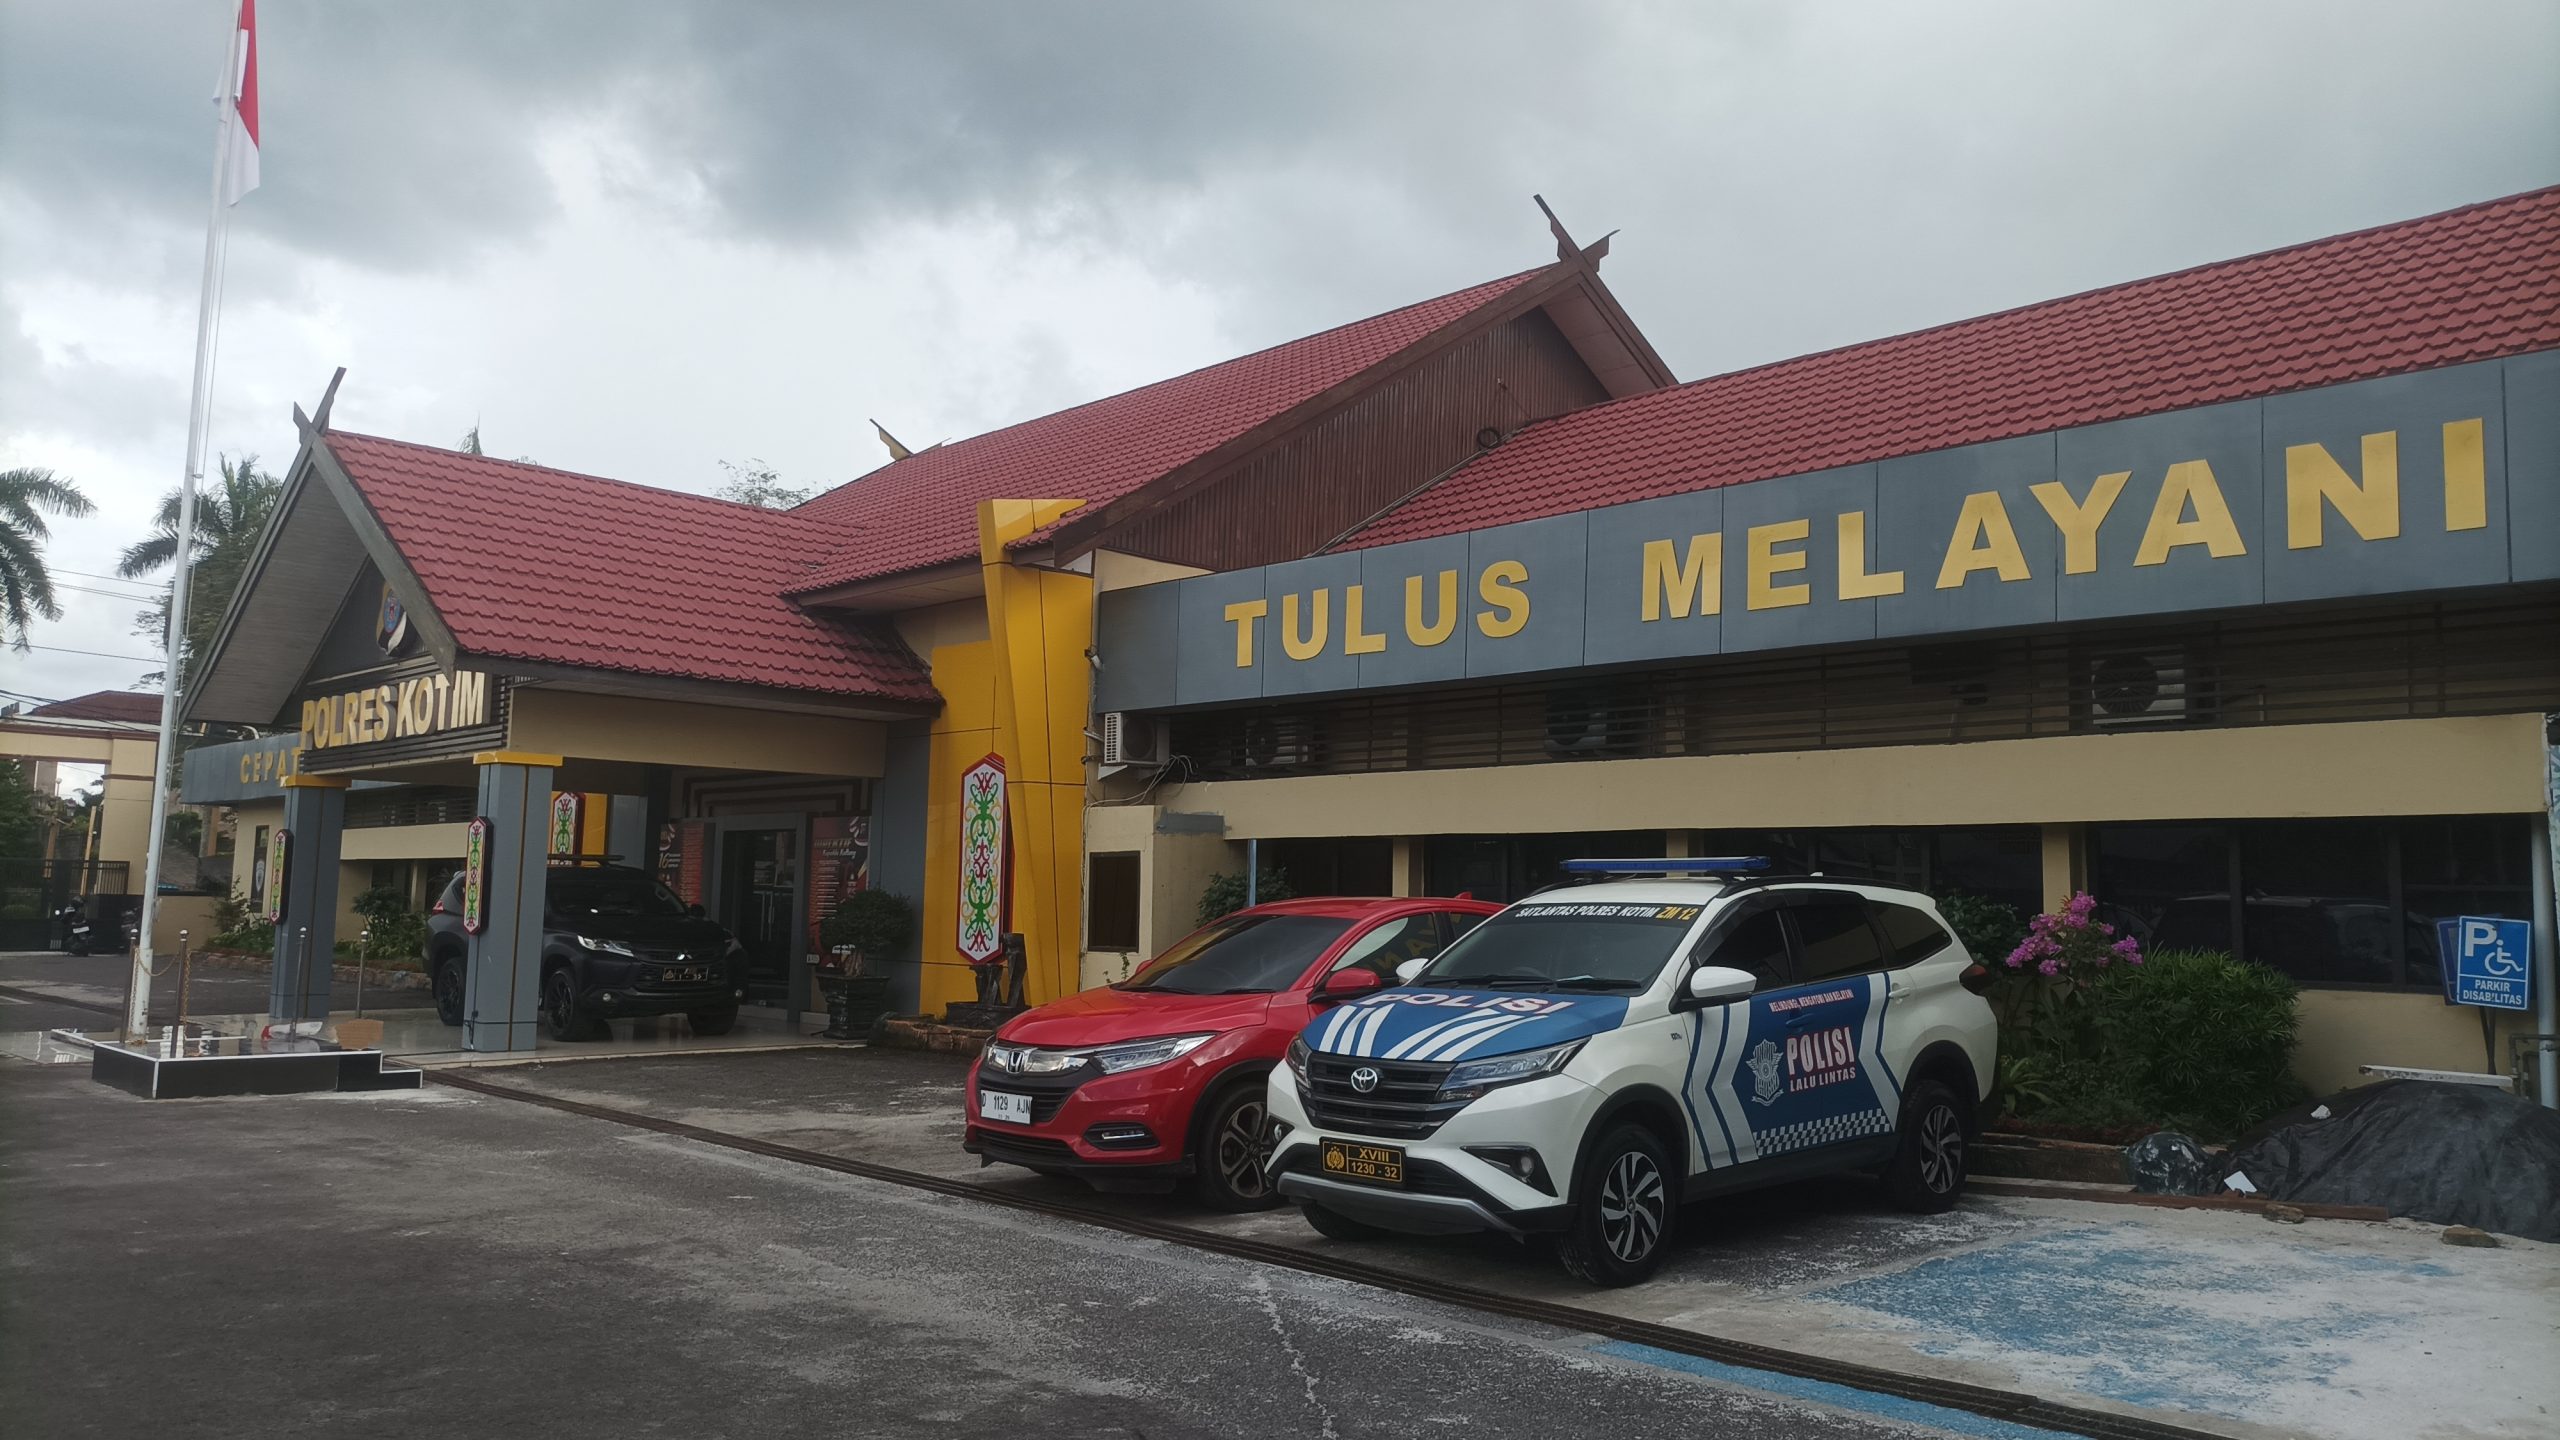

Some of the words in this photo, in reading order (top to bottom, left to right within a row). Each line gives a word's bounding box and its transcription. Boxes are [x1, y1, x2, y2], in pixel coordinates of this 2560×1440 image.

[1224, 560, 1531, 668] TULUS
[1641, 417, 2487, 623] MELAYANI
[301, 686, 390, 749] POLRES
[395, 669, 485, 738] KOTIM
[240, 746, 301, 784] CEPAT
[1515, 906, 1575, 918] SATLANTAS
[1575, 905, 1622, 917] POLRES
[1618, 906, 1661, 918] KOTIM
[1655, 906, 1684, 919] ZM
[1678, 907, 1699, 920] 12
[2464, 921, 2497, 957] P
[2474, 979, 2511, 992] PARKIR
[1359, 993, 1575, 1015] POLISI
[2462, 989, 2522, 1005] DISABILITAS
[1786, 1026, 1856, 1075] POLISI
[1789, 1074, 1816, 1092] LALU
[1819, 1066, 1857, 1086] LINTAS
[993, 1094, 1009, 1111] 1129
[1017, 1098, 1031, 1115] AJN
[1359, 1148, 1389, 1162] XVIII
[1351, 1162, 1375, 1175] 1230
[1384, 1166, 1398, 1178] 32
